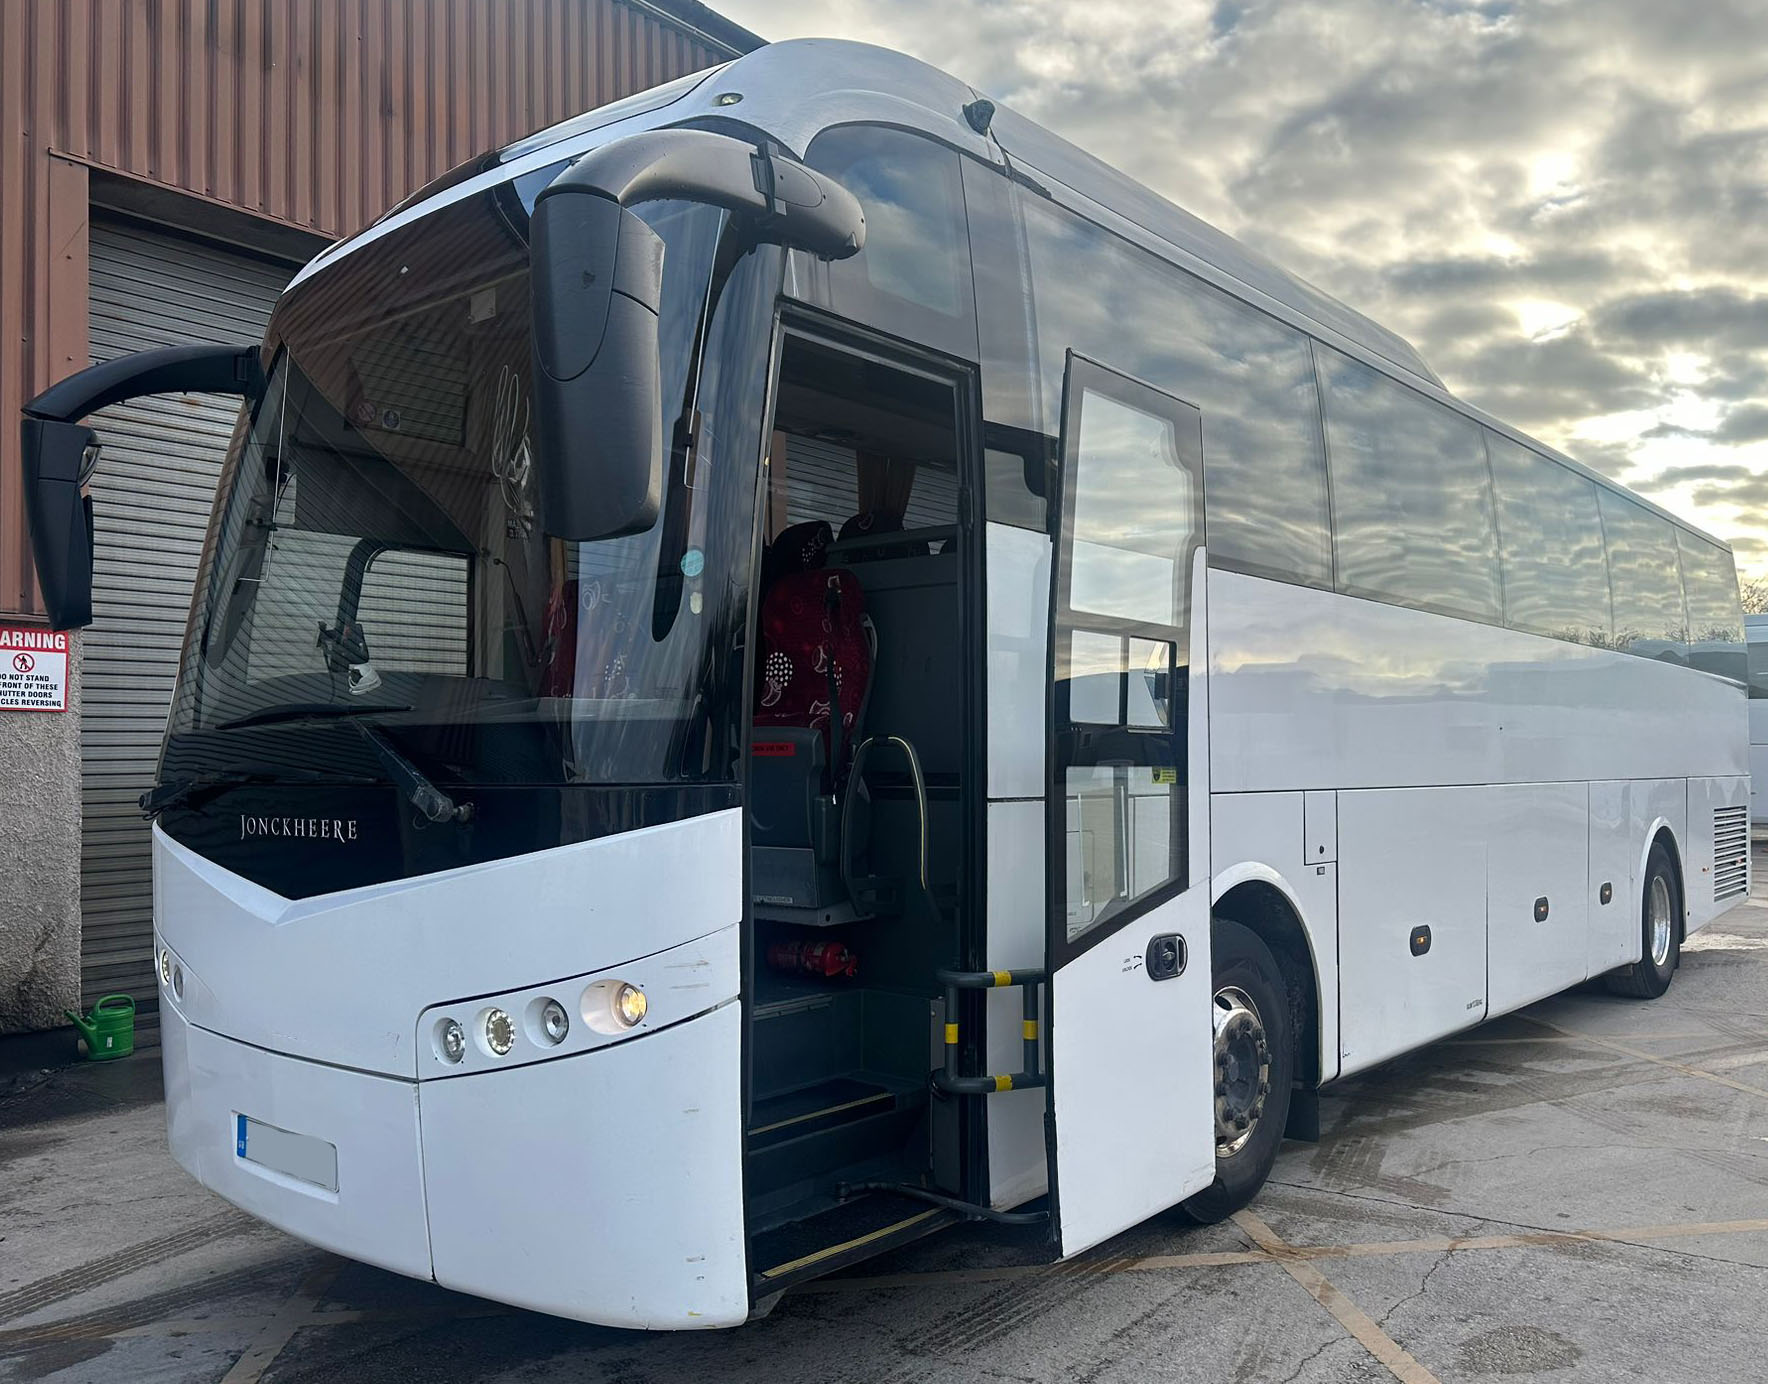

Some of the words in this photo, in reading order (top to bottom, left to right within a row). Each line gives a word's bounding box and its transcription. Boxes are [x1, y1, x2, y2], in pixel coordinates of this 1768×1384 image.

[9, 673, 24, 681] NOT
[26, 674, 50, 682] STAND
[36, 683, 58, 691] THESE
[28, 691, 53, 699] DOORS
[21, 699, 62, 708] REVERSING
[240, 814, 358, 844] JONCKHEERE
